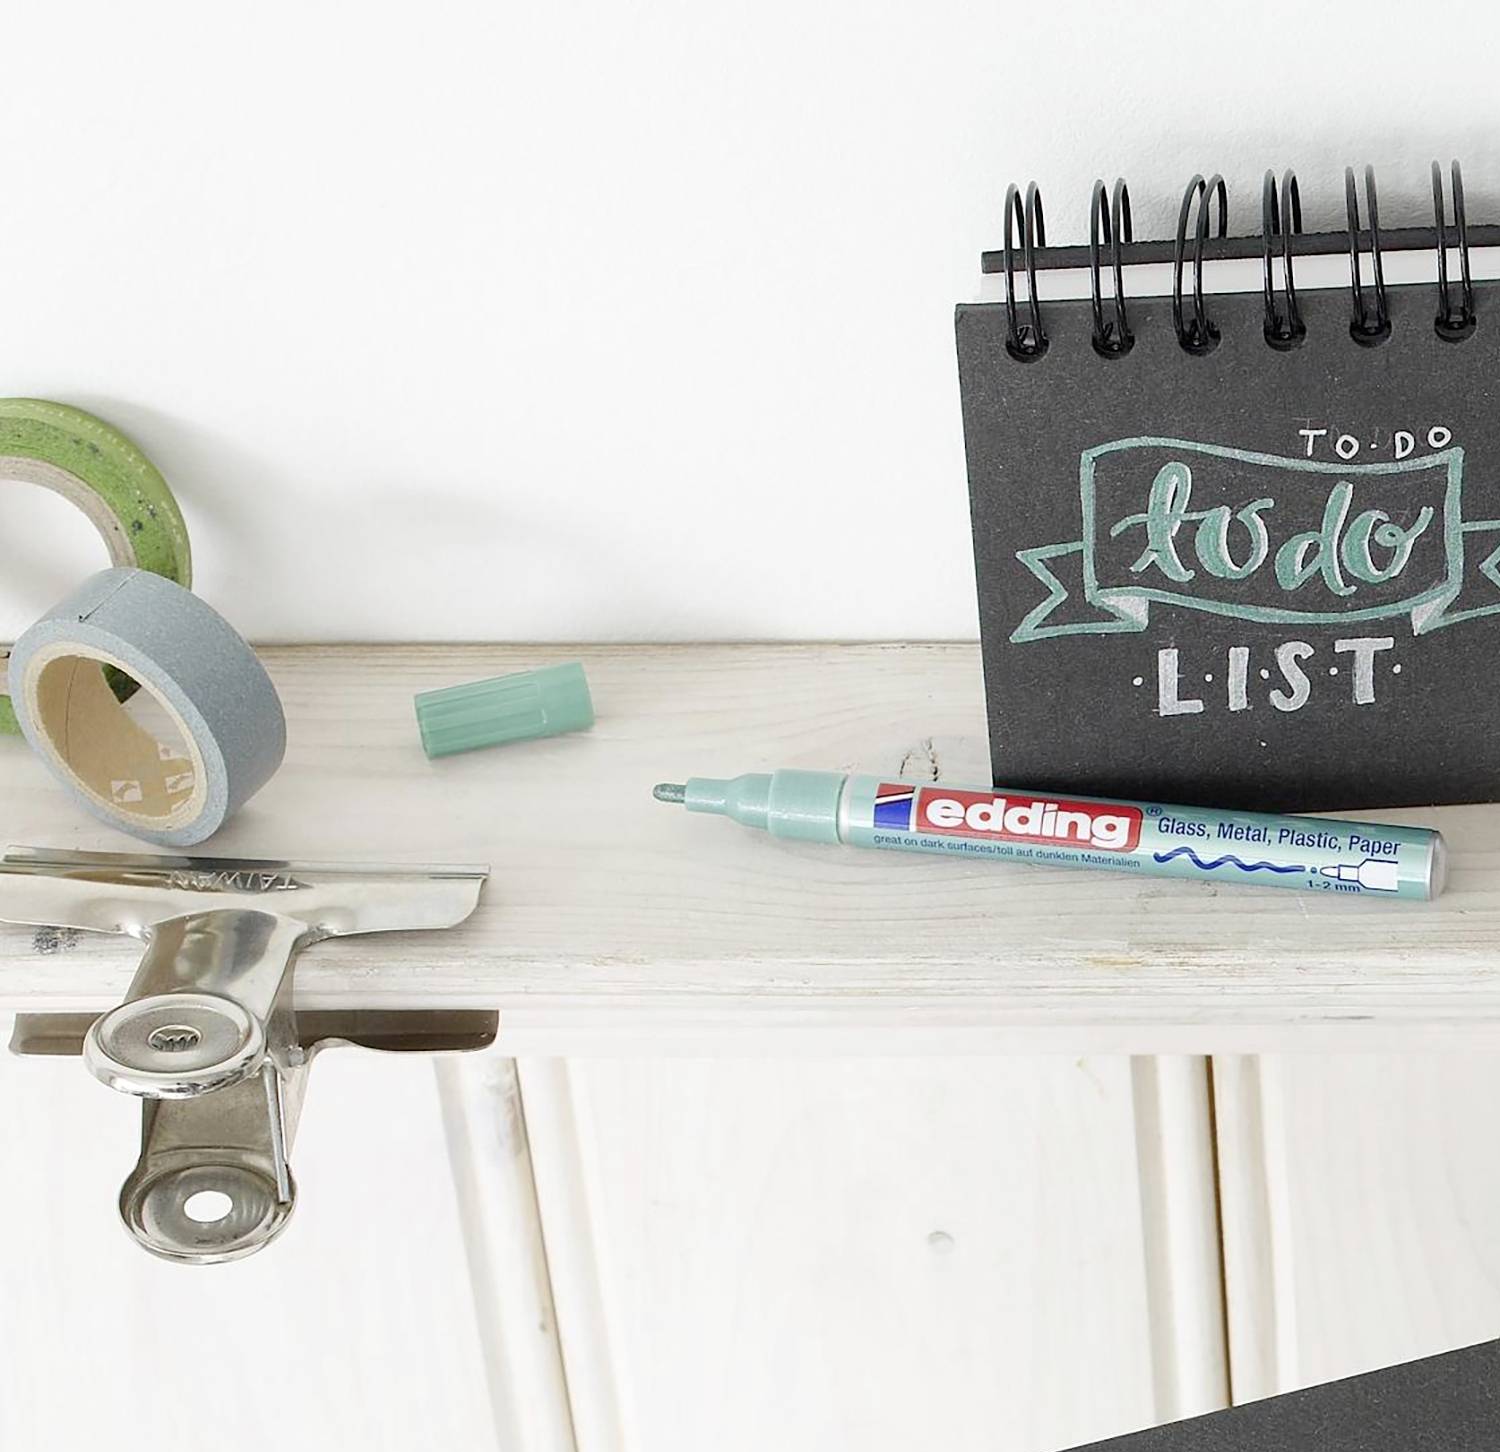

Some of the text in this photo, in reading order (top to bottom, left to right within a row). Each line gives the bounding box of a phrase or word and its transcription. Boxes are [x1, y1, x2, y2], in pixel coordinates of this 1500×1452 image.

[925, 797, 1131, 850] edding
[1157, 815, 1402, 857] Glass, Metal, Plastic, Paper
[873, 834, 902, 847] great
[904, 837, 918, 847] on
[920, 836, 945, 850] dark
[1016, 846, 1034, 858] auf
[1035, 849, 1080, 863] dunklen
[1081, 853, 1142, 869] Materialien
[1307, 879, 1361, 893] 1-2 mm
